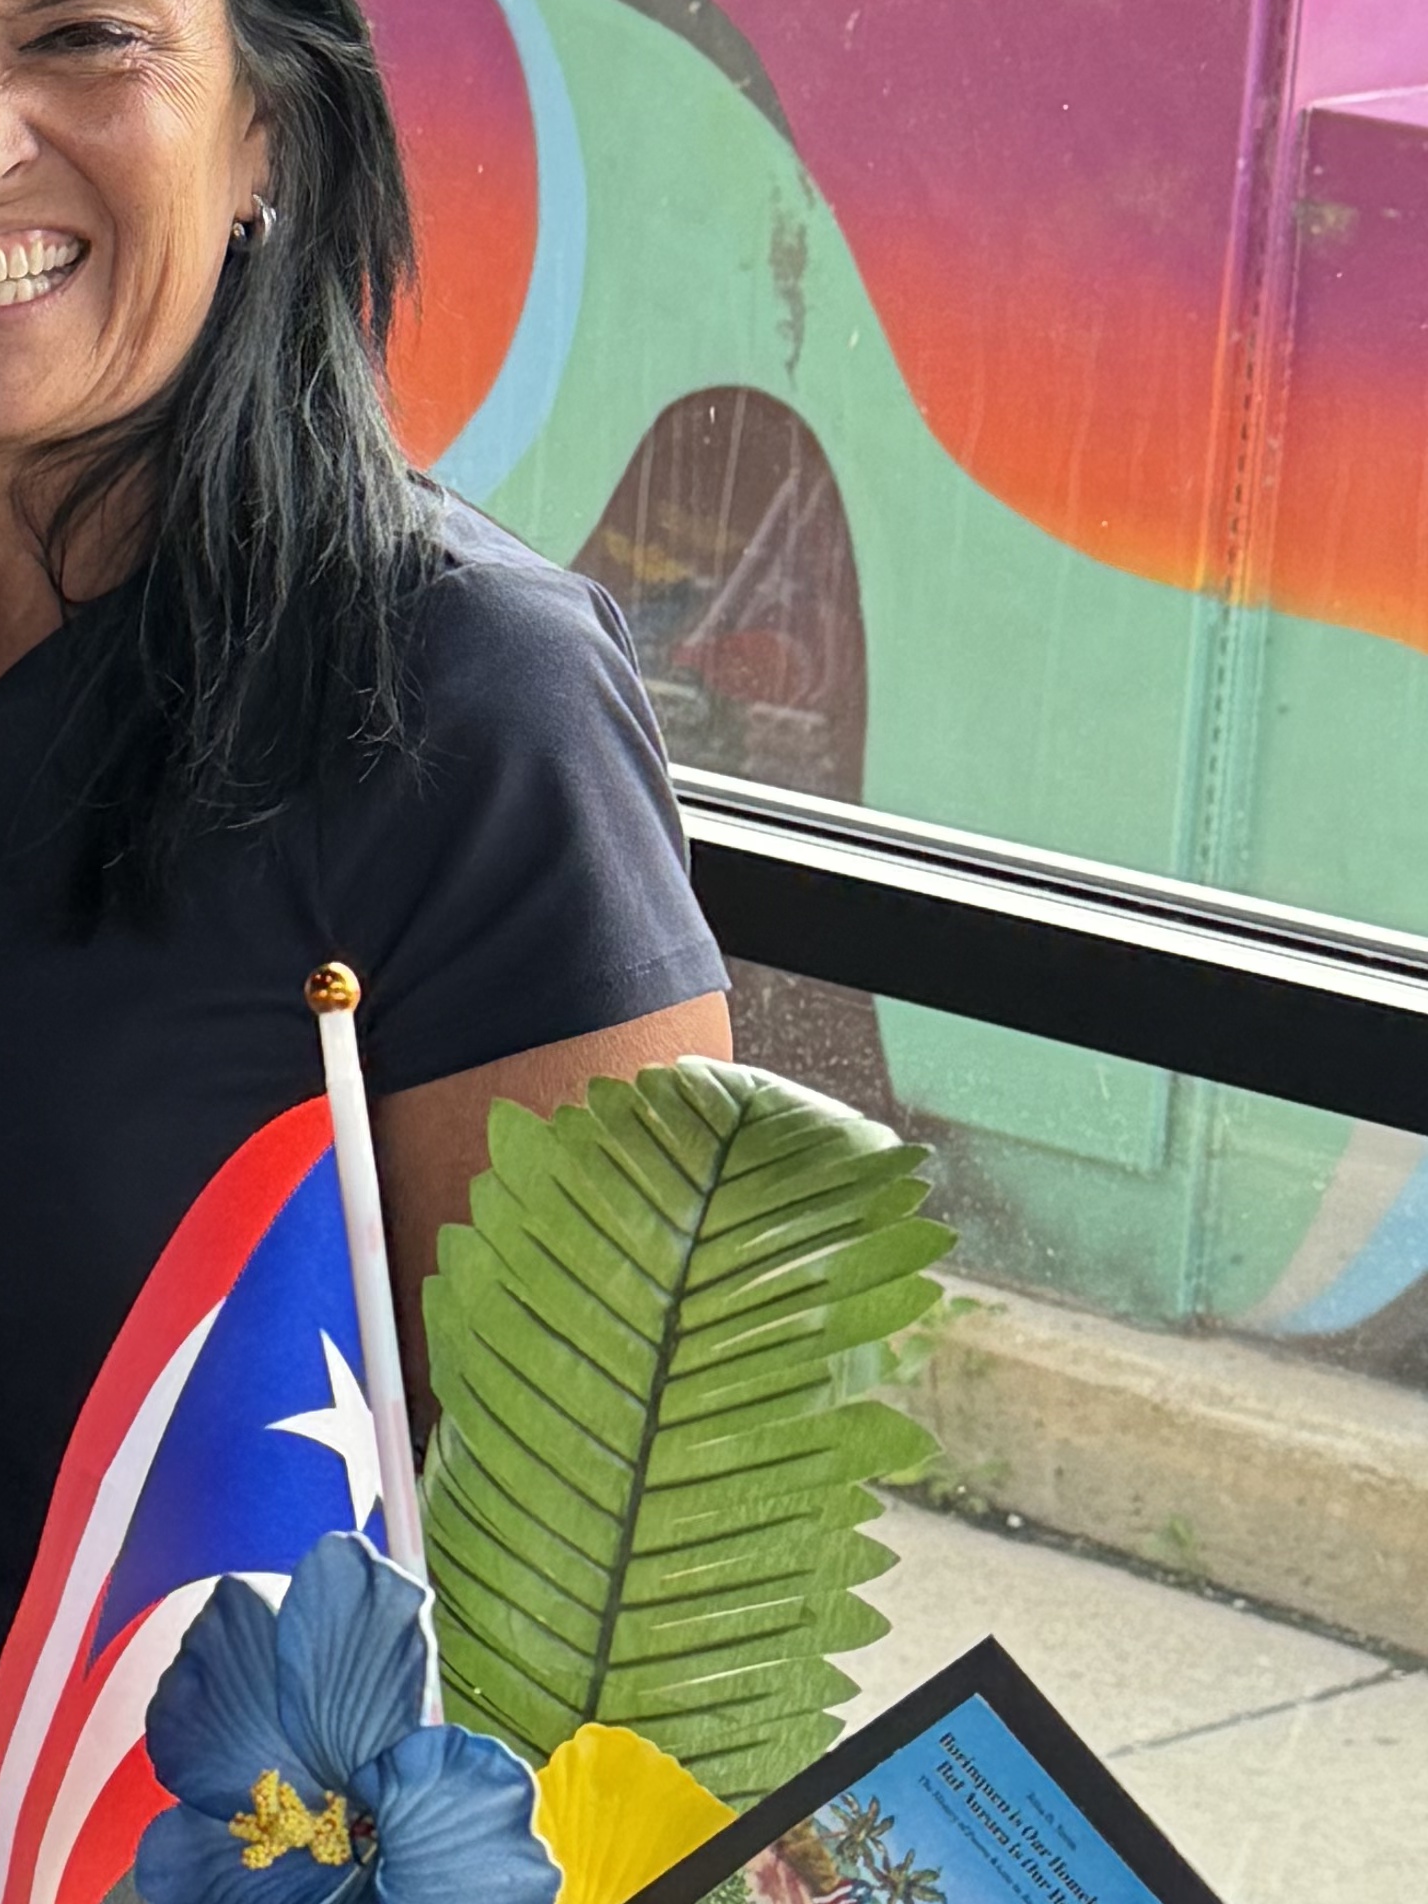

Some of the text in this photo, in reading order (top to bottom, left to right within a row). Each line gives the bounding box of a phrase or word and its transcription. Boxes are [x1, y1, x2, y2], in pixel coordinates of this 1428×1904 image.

[936, 1760, 966, 1792] But
[965, 1791, 1012, 1845] Aurora
[1006, 1840, 1028, 1861] is
[1020, 1855, 1054, 1892] Our
[939, 1732, 1009, 1815] Borinquen
[1006, 1808, 1026, 1828] is
[1019, 1822, 1054, 1860] Our
